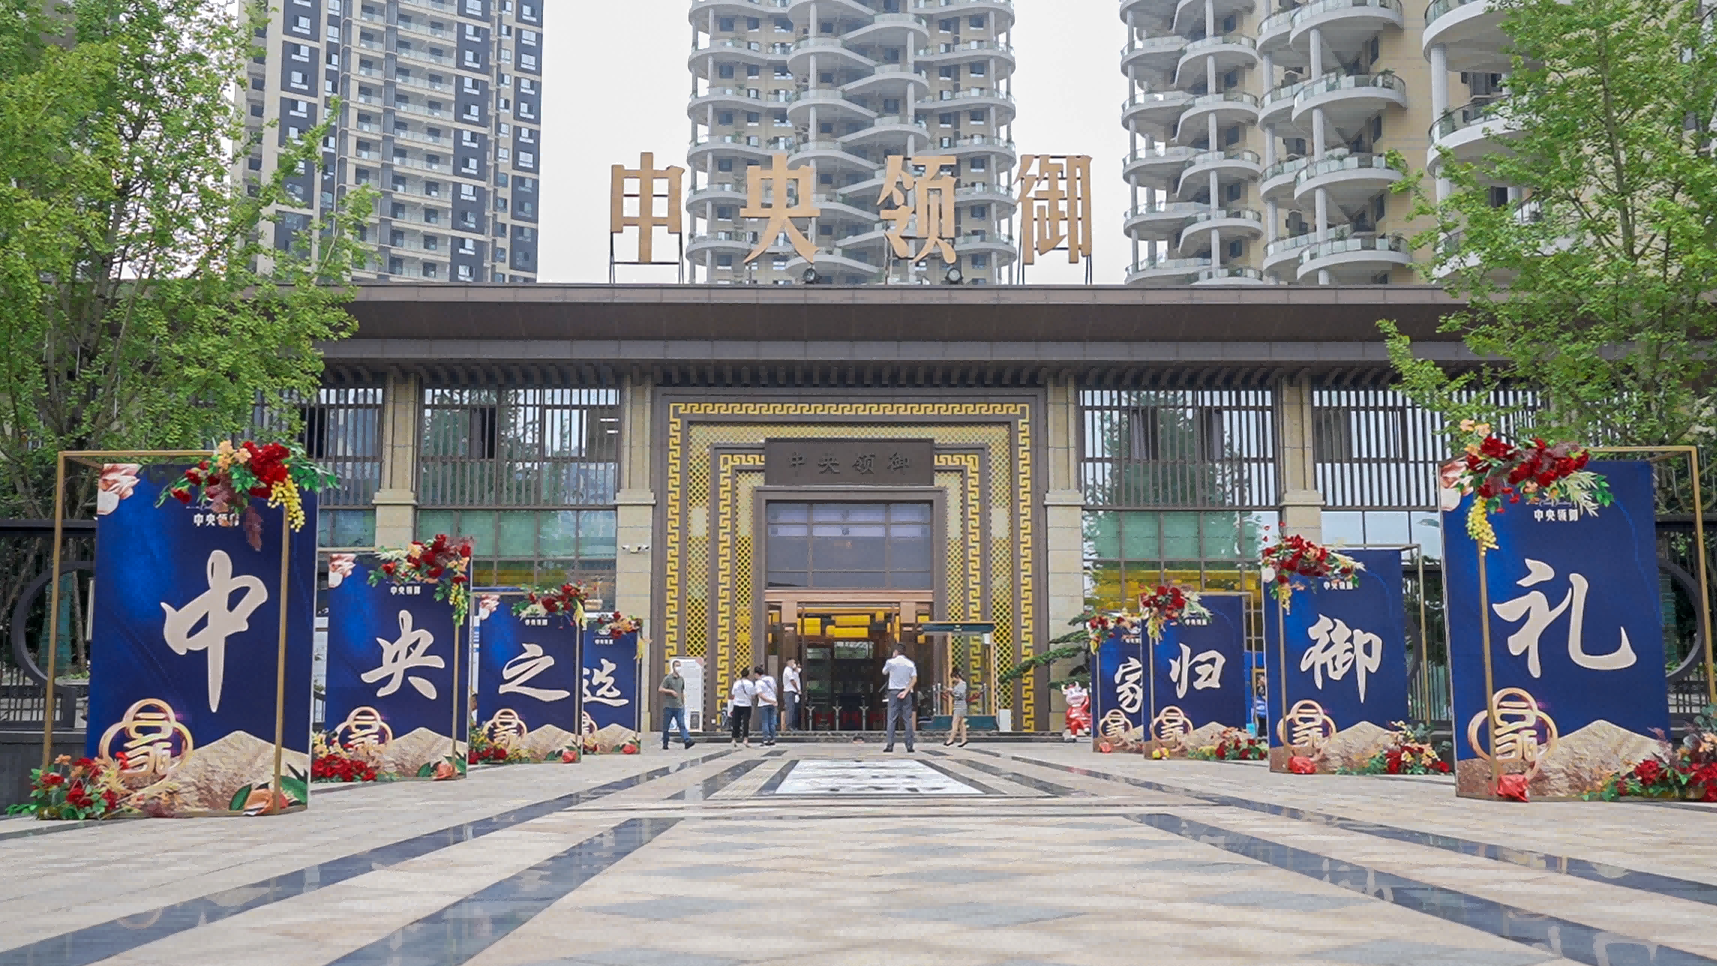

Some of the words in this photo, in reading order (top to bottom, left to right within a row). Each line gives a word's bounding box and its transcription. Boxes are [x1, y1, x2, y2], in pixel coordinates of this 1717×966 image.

[609, 151, 1093, 265] 中央领御
[788, 452, 910, 477] 中央领御
[161, 550, 268, 713] 中
[361, 609, 445, 700] 央
[1299, 613, 1383, 703] 御
[1491, 558, 1637, 679] 礼
[498, 643, 571, 702] 之
[1169, 643, 1225, 699] 归
